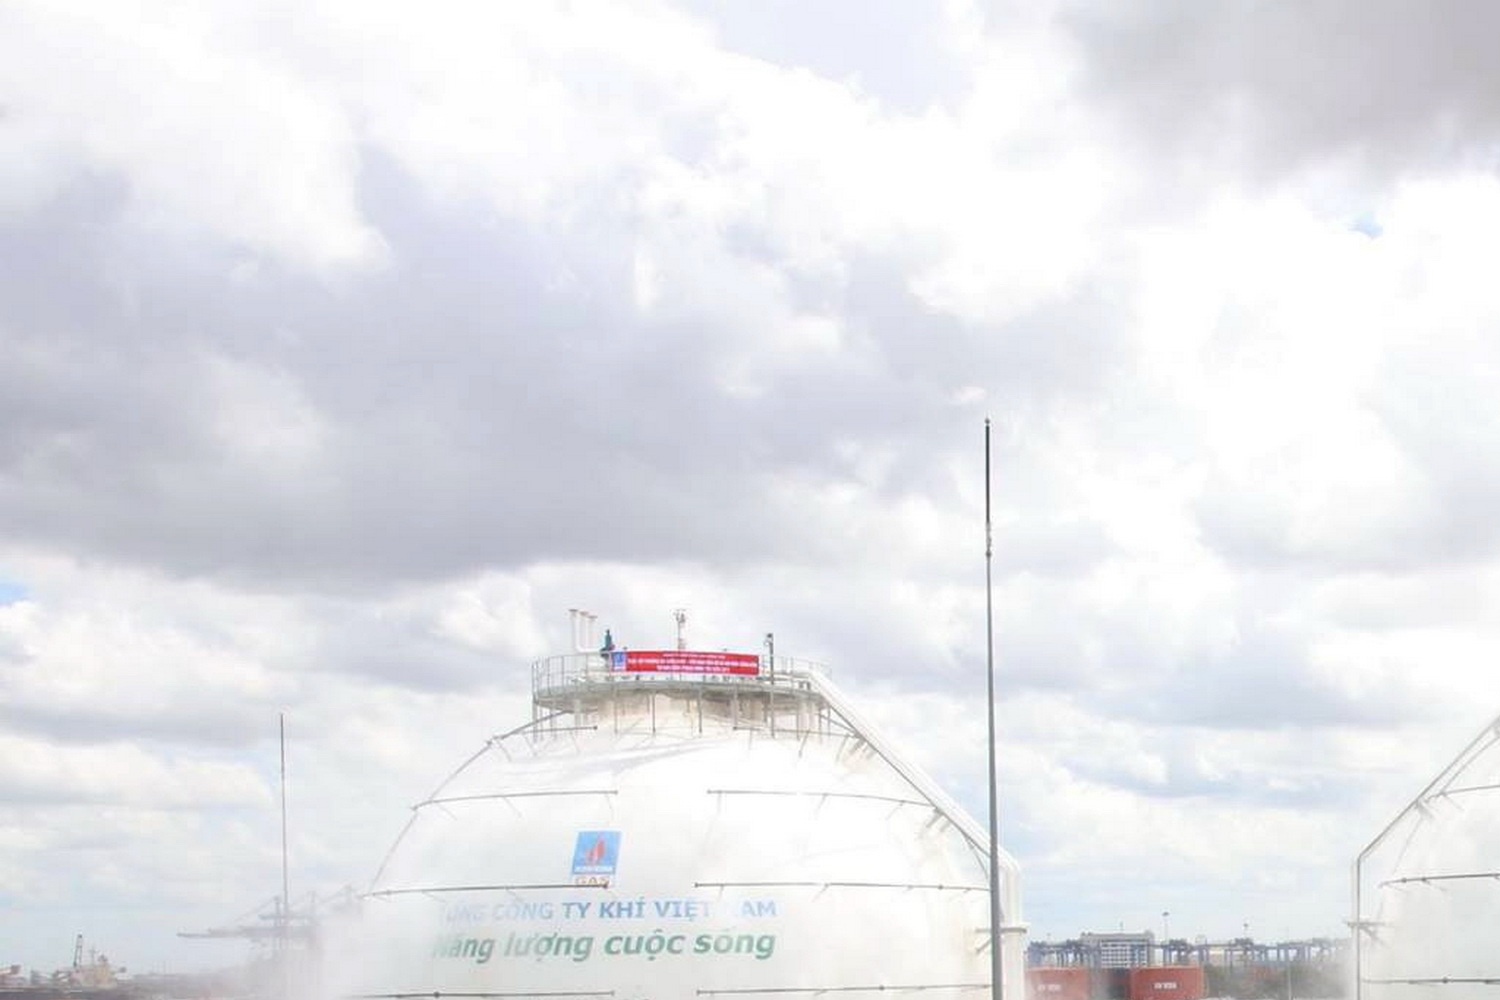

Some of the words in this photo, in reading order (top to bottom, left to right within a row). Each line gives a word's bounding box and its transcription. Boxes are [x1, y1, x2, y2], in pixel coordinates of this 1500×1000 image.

[562, 902, 591, 919] TY
[600, 897, 646, 918] KHÍ
[503, 932, 594, 962] lượng
[604, 929, 686, 961] cuộc
